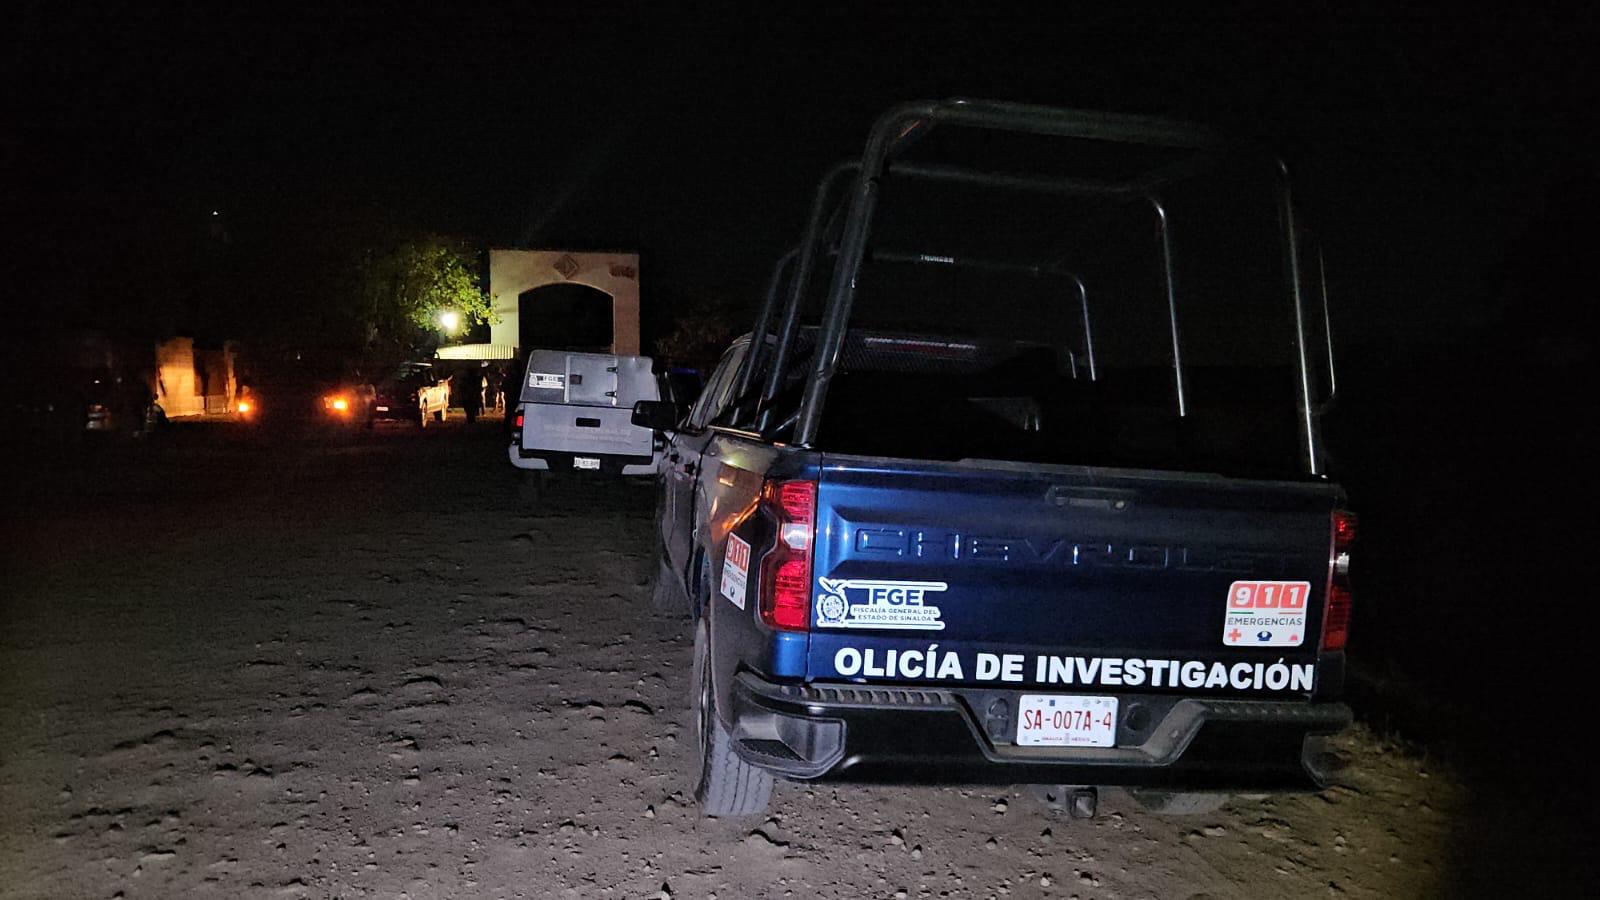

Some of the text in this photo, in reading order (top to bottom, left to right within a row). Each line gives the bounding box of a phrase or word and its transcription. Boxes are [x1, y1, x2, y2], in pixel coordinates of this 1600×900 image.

[727, 541, 747, 567] 911
[872, 588, 921, 606] FGE
[1235, 586, 1300, 606] 911
[1227, 617, 1303, 626] EMERGENCIAS
[834, 644, 1315, 691] OLICÍA DE INVESTIGACIÓN
[1024, 709, 1112, 731] SA-007A-4
